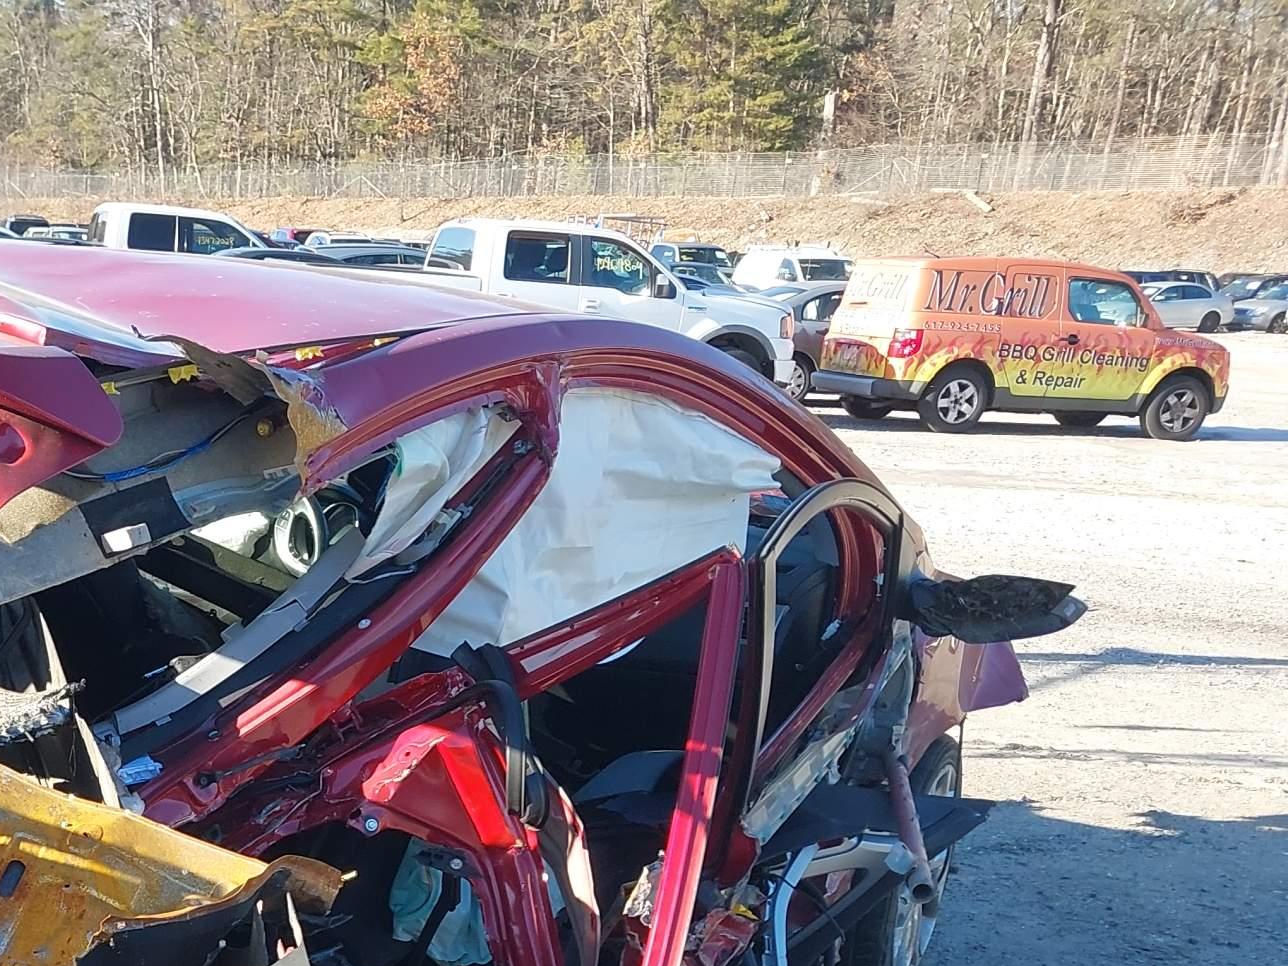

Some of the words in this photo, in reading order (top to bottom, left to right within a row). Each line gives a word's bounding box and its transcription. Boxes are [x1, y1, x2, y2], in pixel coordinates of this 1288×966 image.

[978, 272, 1051, 318] Grill
[998, 343, 1037, 361] BBQ
[1042, 346, 1075, 363] Grill
[1079, 349, 1151, 373] Cleaning
[1015, 369, 1028, 385] &
[1032, 370, 1086, 390] Repair
